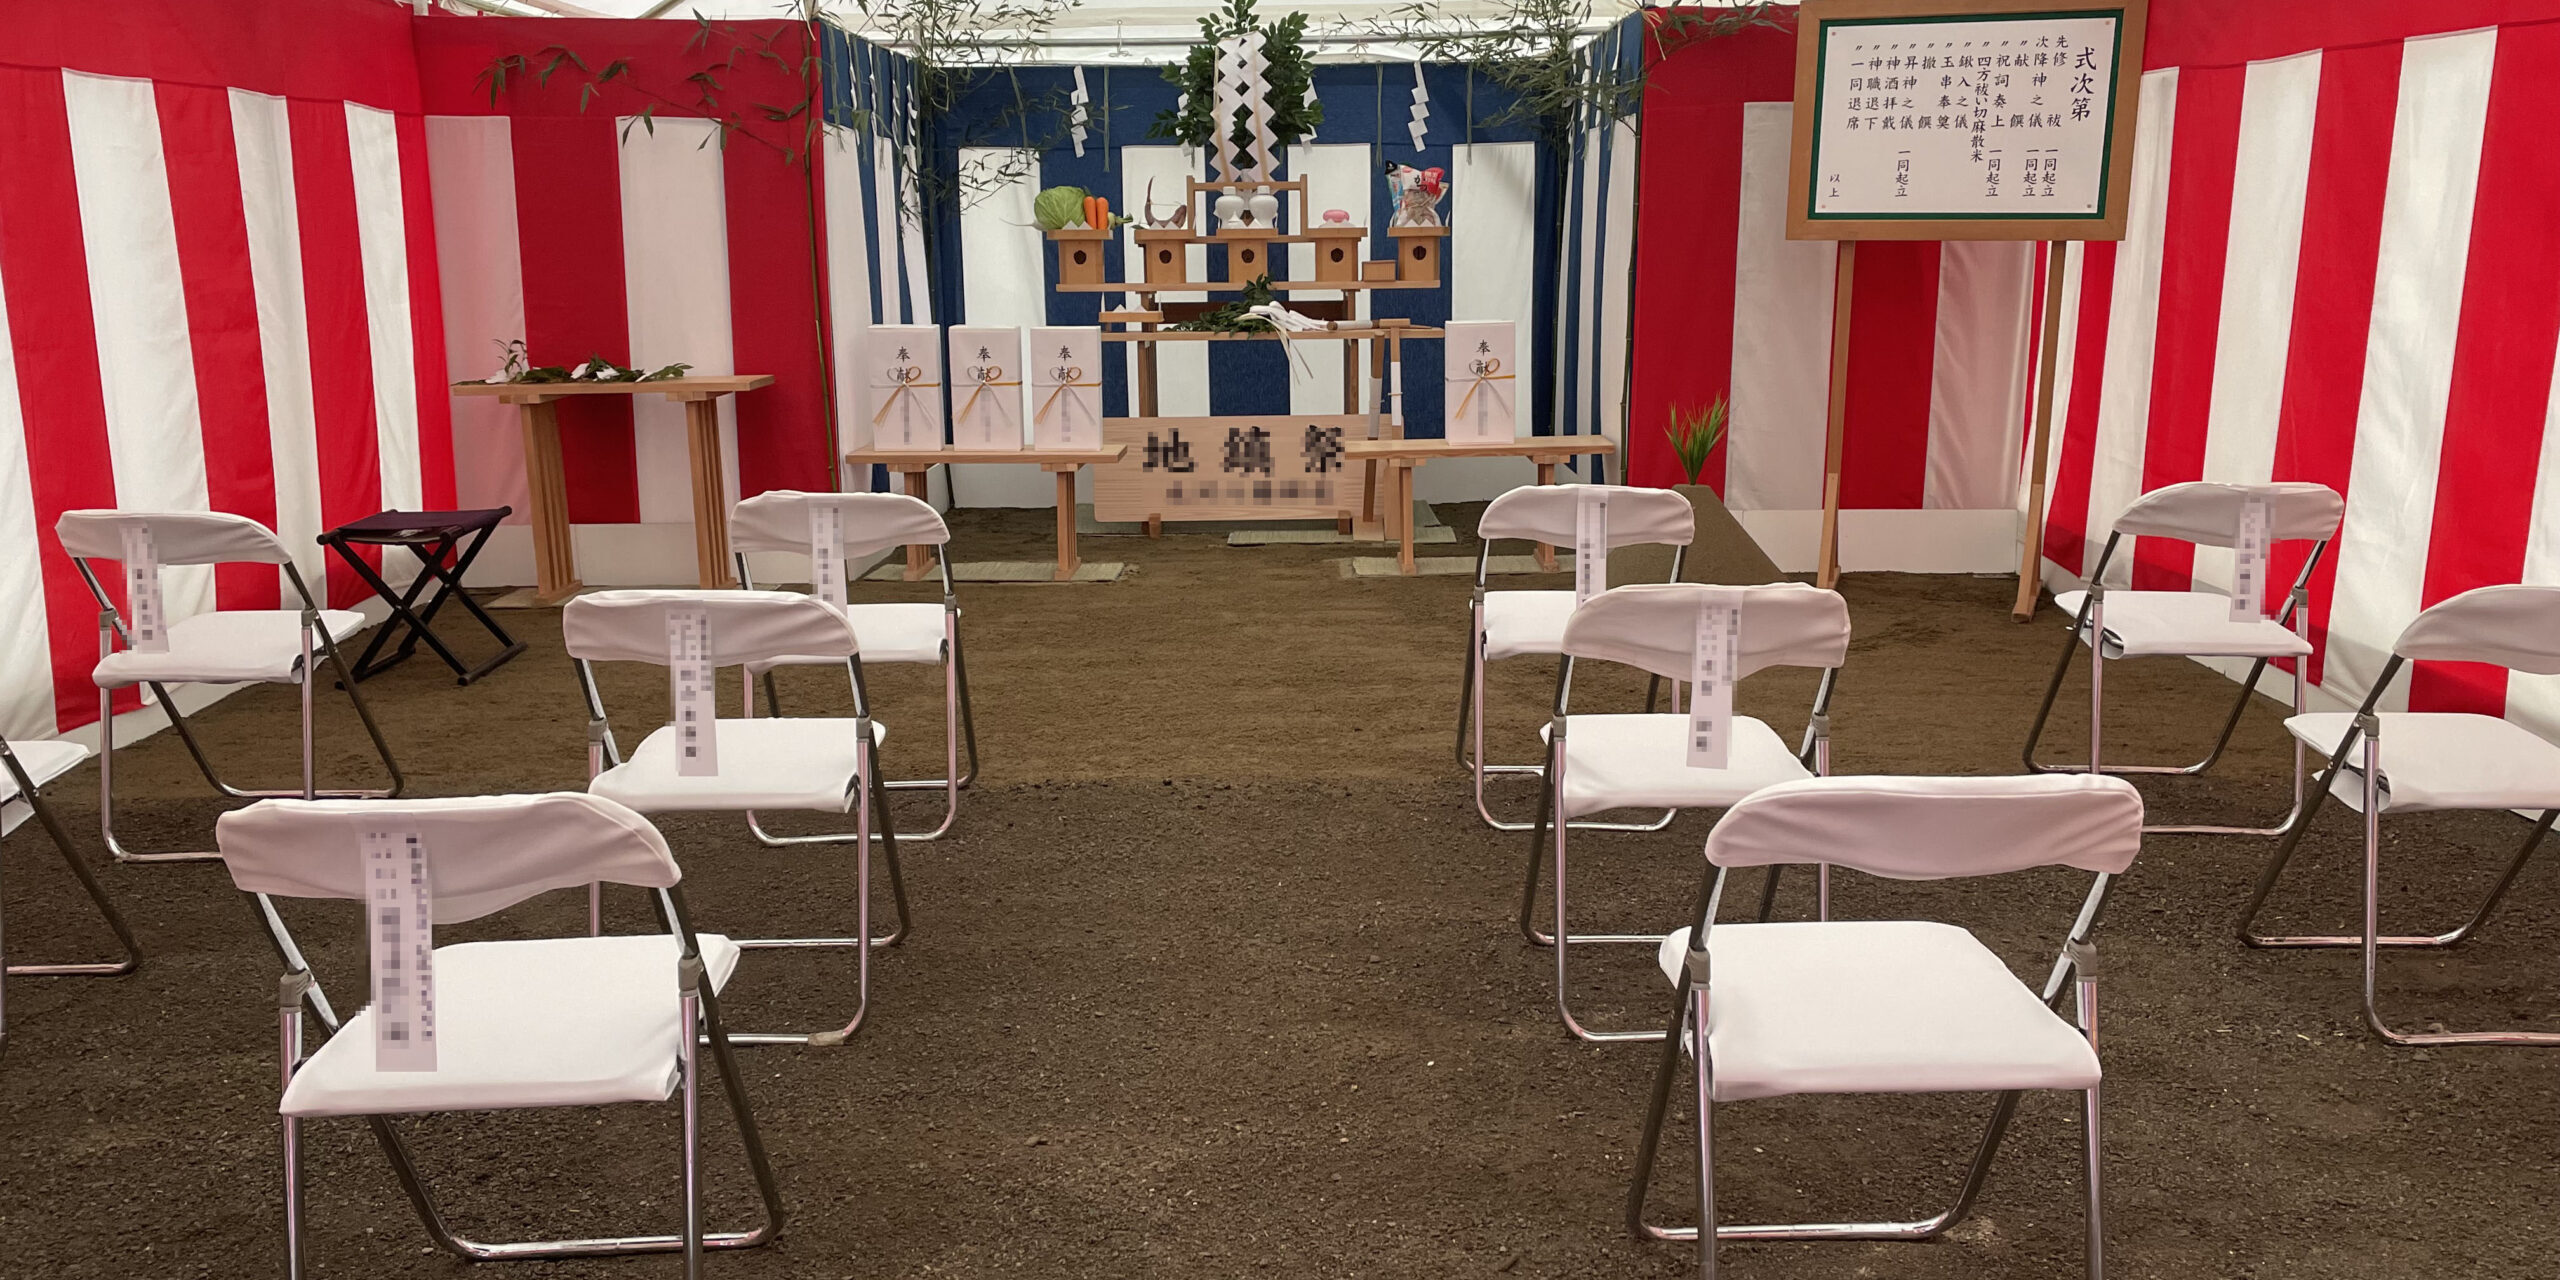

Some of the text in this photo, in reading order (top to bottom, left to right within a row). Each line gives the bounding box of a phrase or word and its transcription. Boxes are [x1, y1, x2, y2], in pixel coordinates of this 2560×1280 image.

[2070, 46, 2097, 122] 式次第
[1828, 173, 1841, 198] 以上
[1895, 150, 1911, 198] 一同起立
[1985, 149, 2003, 198] 一同起立
[2022, 148, 2040, 198] 一同起立
[2041, 148, 2059, 197] 一同起立
[896, 346, 911, 381] 奉献
[976, 346, 991, 381] 奉献
[1057, 345, 1072, 380] 奉献
[1476, 339, 1491, 374] 奉献
